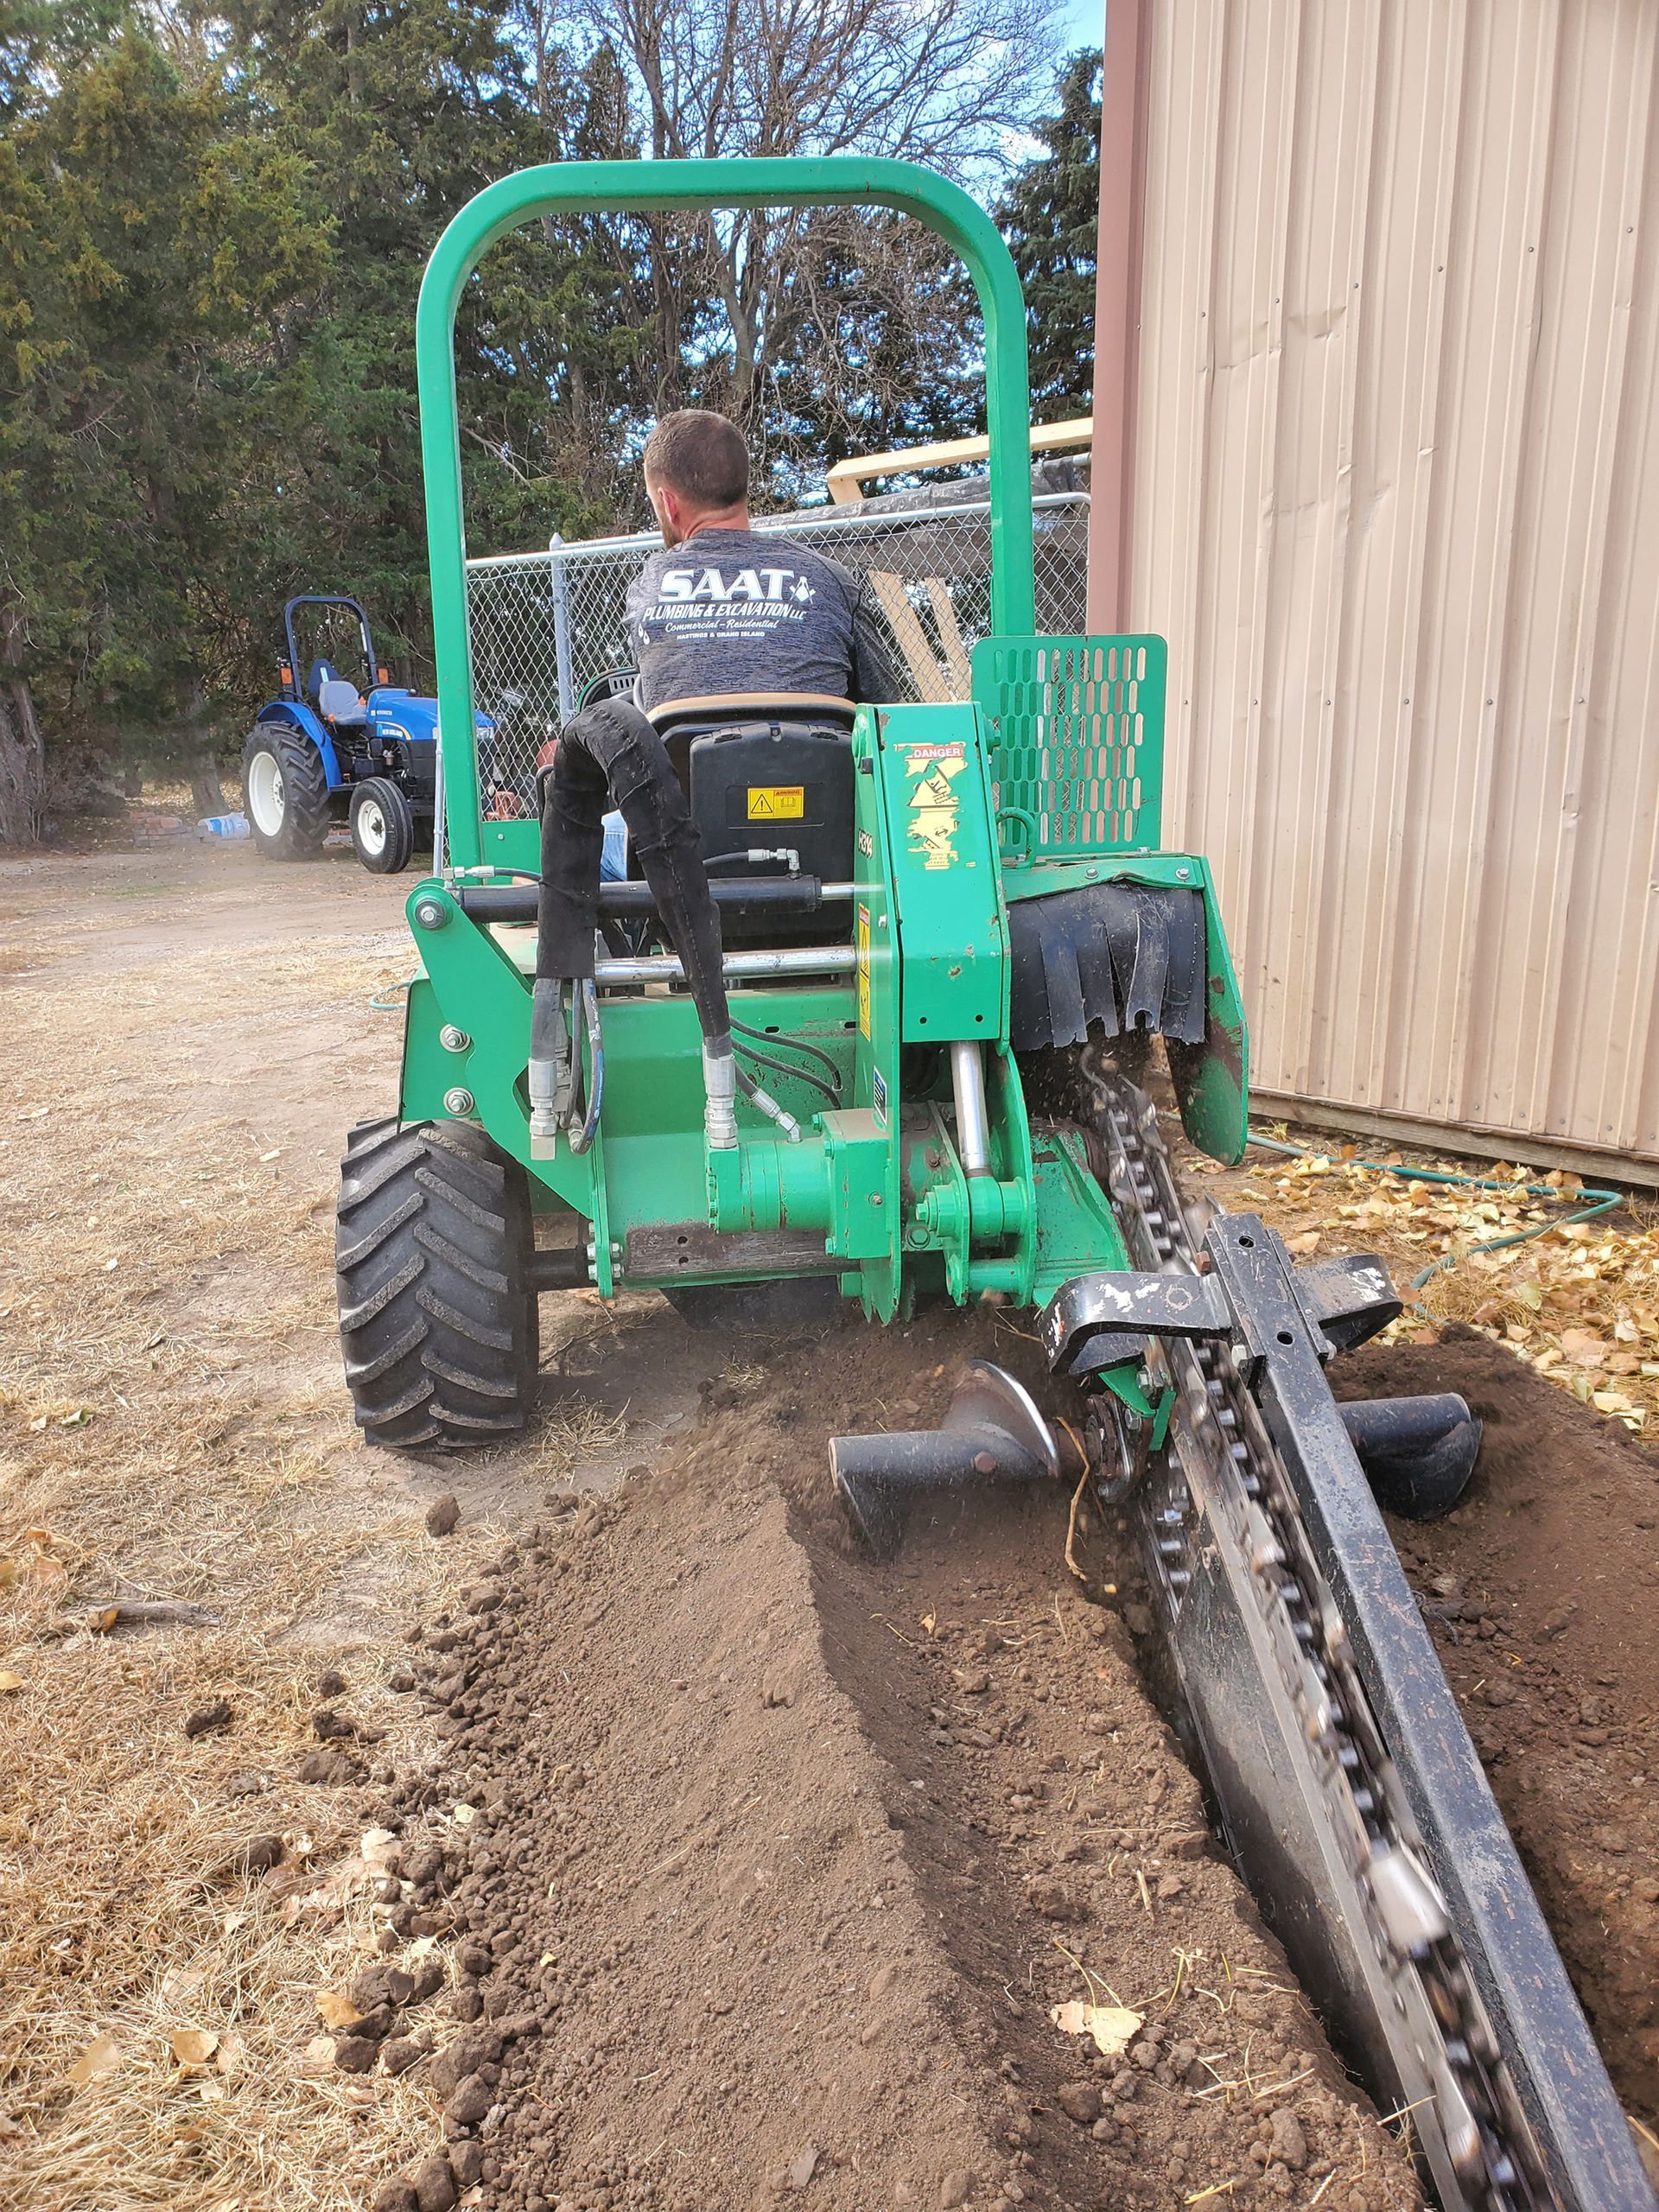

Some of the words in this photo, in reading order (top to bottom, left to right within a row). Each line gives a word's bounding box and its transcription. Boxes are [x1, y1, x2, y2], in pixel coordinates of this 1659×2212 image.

[658, 568, 794, 602] SAAT
[642, 603, 706, 622] PLUMBING
[703, 603, 716, 617] &
[715, 602, 792, 617] EXCAVATION
[789, 609, 807, 620] LLC
[665, 620, 720, 632] Commercial
[727, 619, 780, 629] Residential
[677, 632, 708, 640] HASTINGS
[914, 747, 961, 758] DANGER
